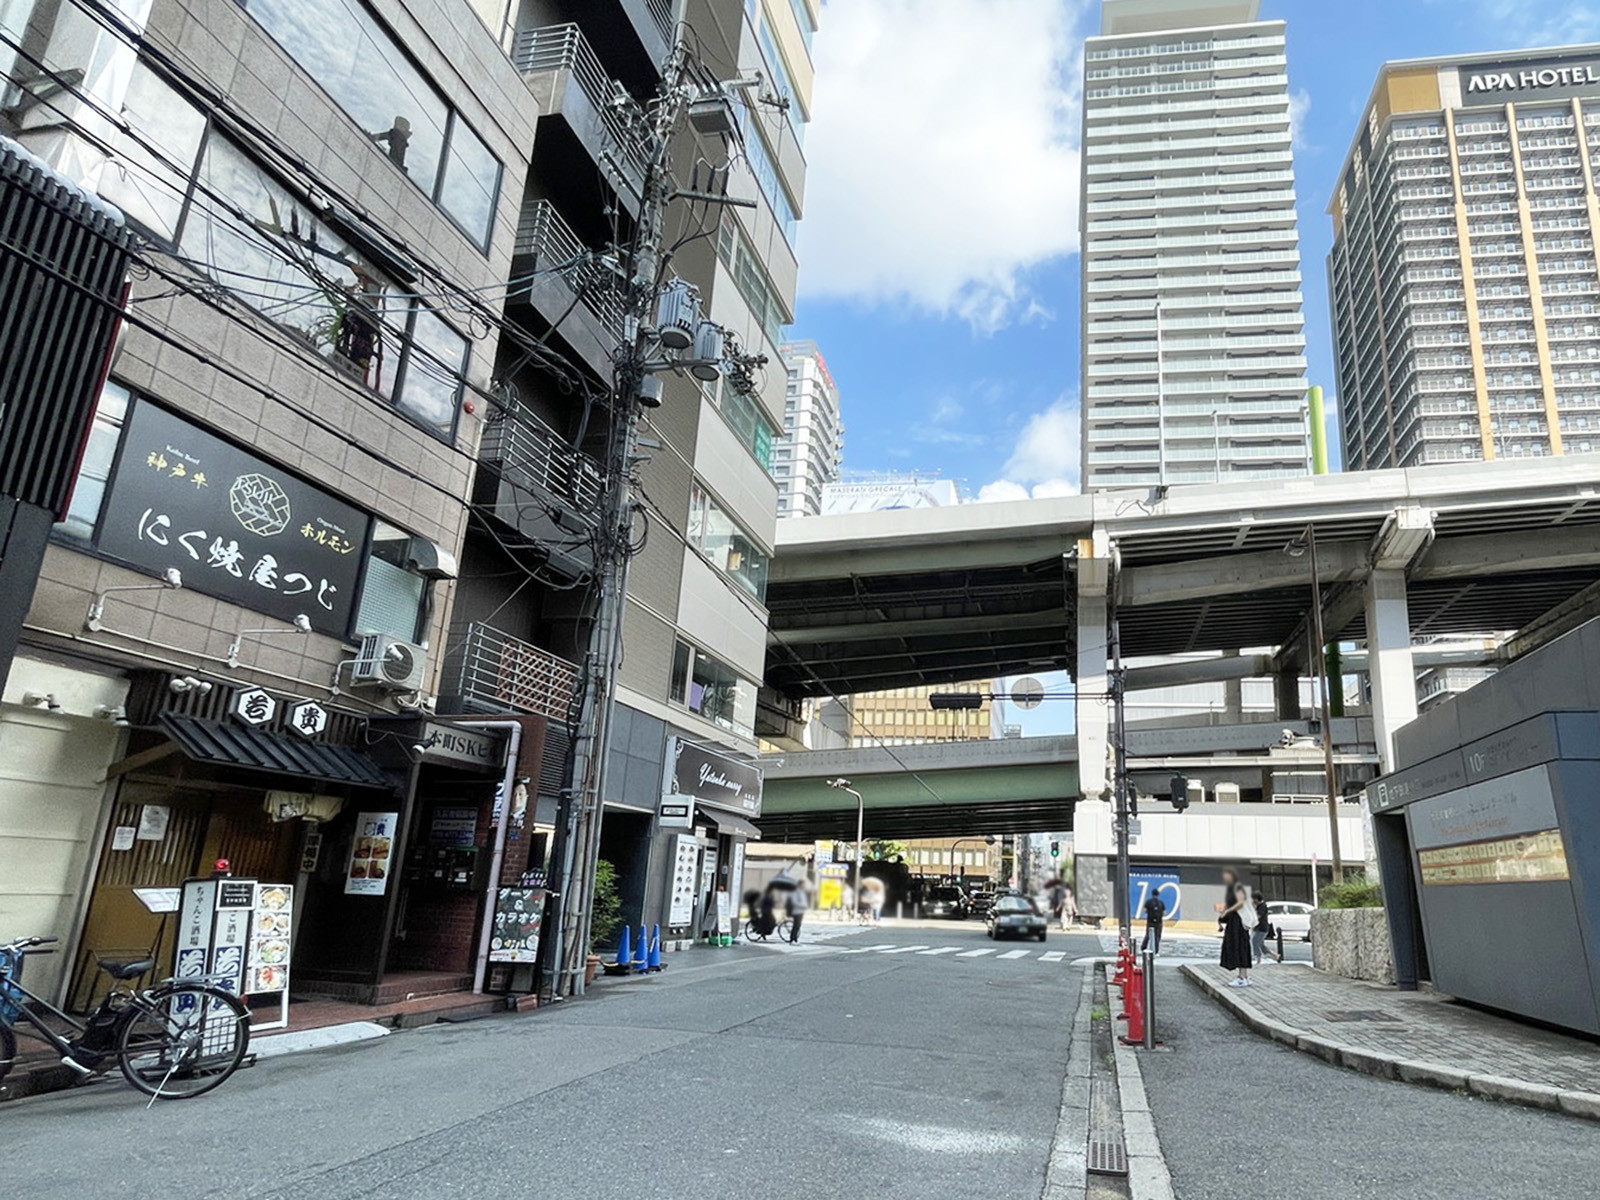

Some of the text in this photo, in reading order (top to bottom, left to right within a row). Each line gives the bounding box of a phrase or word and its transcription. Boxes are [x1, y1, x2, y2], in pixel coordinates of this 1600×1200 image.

[1468, 66, 1600, 91] APA HOTEL
[147, 451, 208, 489] 神戸牛
[868, 485, 902, 493] GRECALE
[300, 522, 356, 554] ホルモン
[189, 886, 204, 946] ちゃんこ酒場
[496, 911, 542, 924] カラオケ
[514, 899, 525, 911] &
